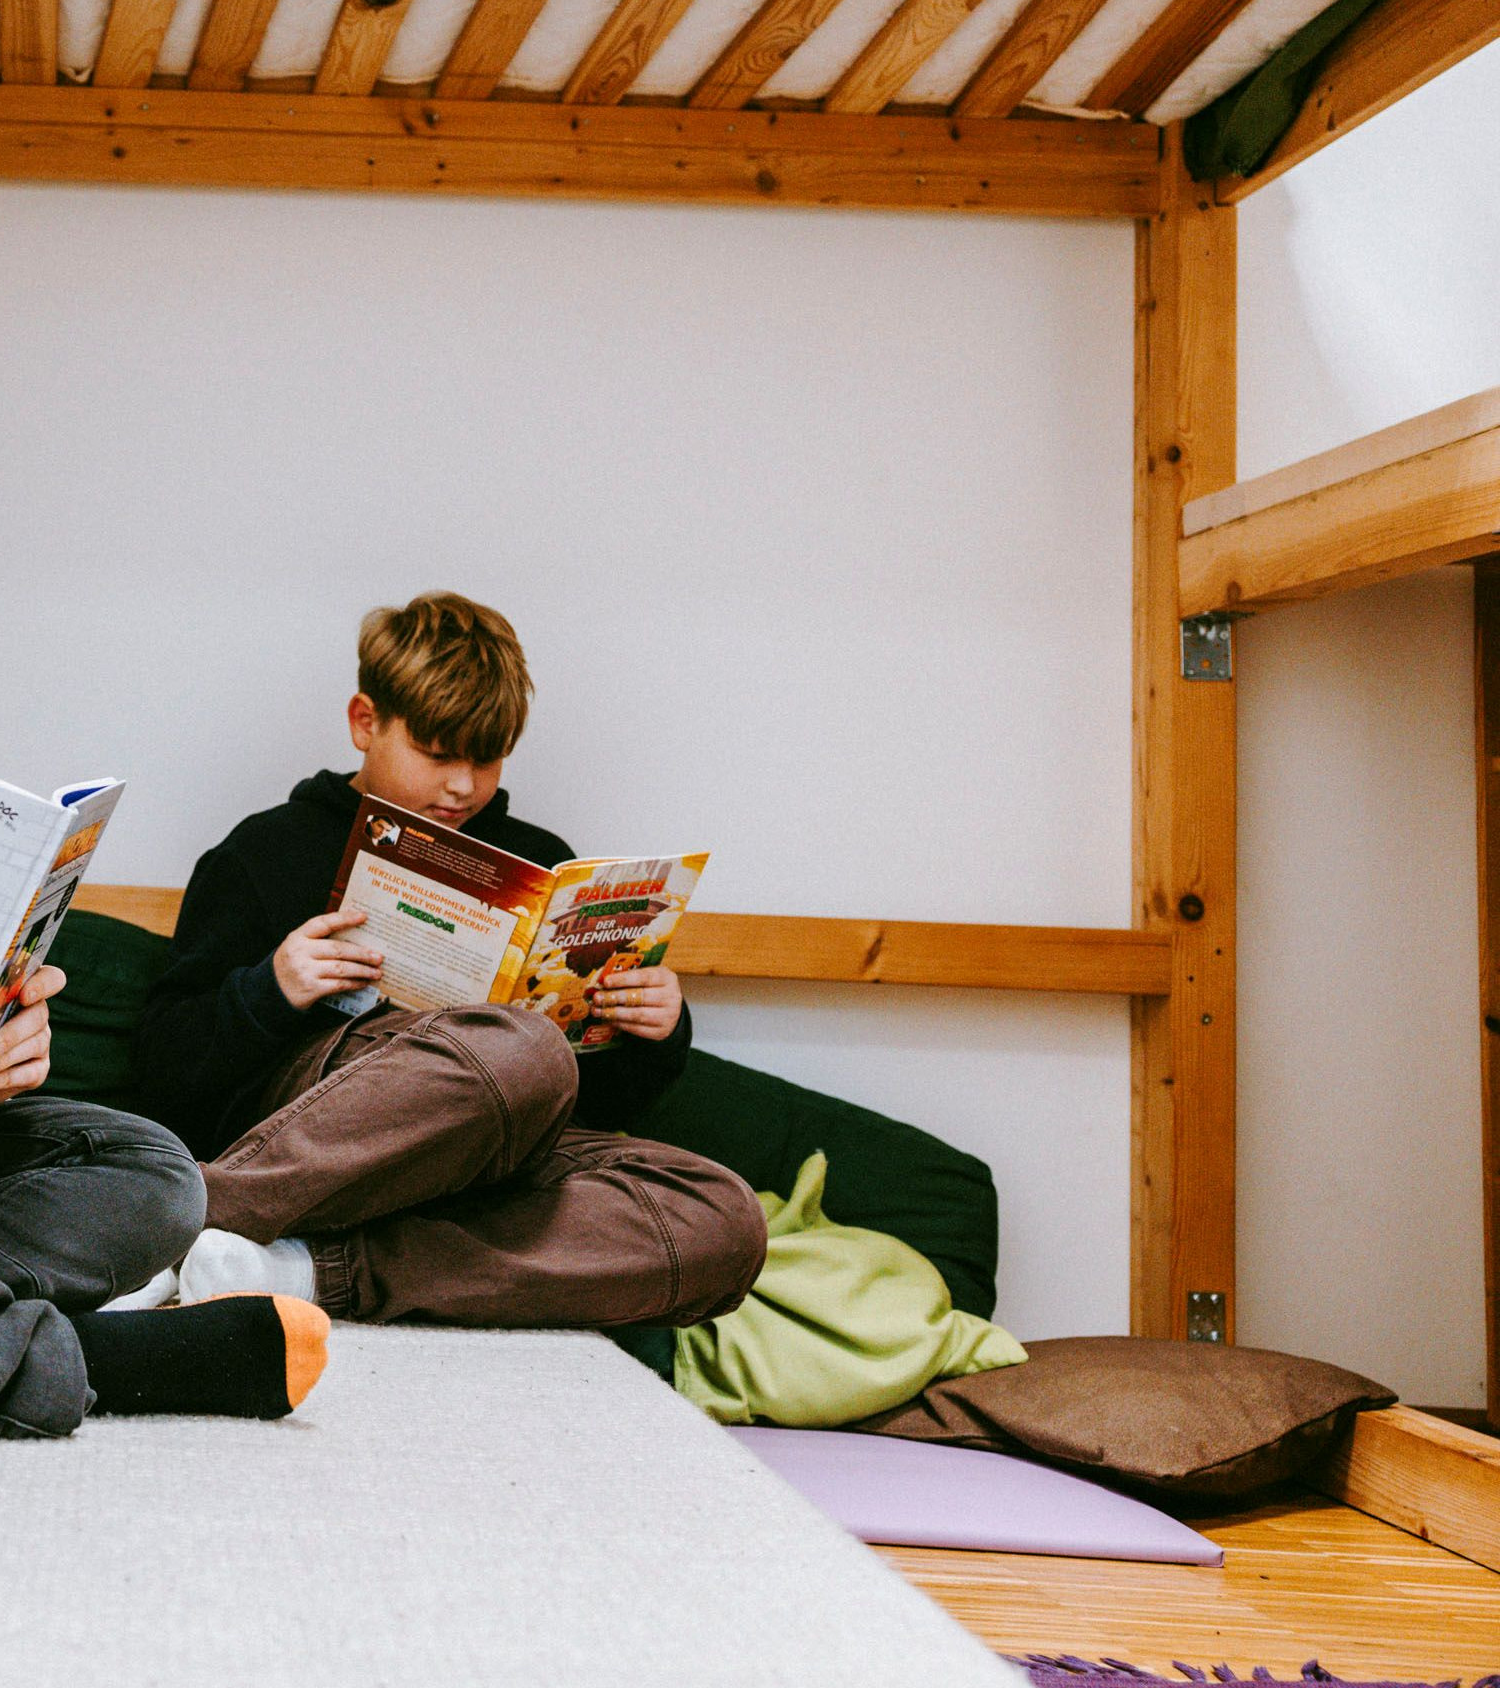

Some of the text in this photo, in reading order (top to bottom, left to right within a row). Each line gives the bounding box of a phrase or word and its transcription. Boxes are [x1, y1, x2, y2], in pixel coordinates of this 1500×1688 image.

[367, 865, 408, 887] HERZLICH
[410, 882, 467, 913] WILLKOMMEN
[371, 879, 381, 888] IN
[382, 884, 400, 896] DER
[401, 890, 424, 905] WELT
[425, 901, 443, 914] VON
[574, 877, 667, 903] PALUTEN
[596, 920, 617, 931] DER
